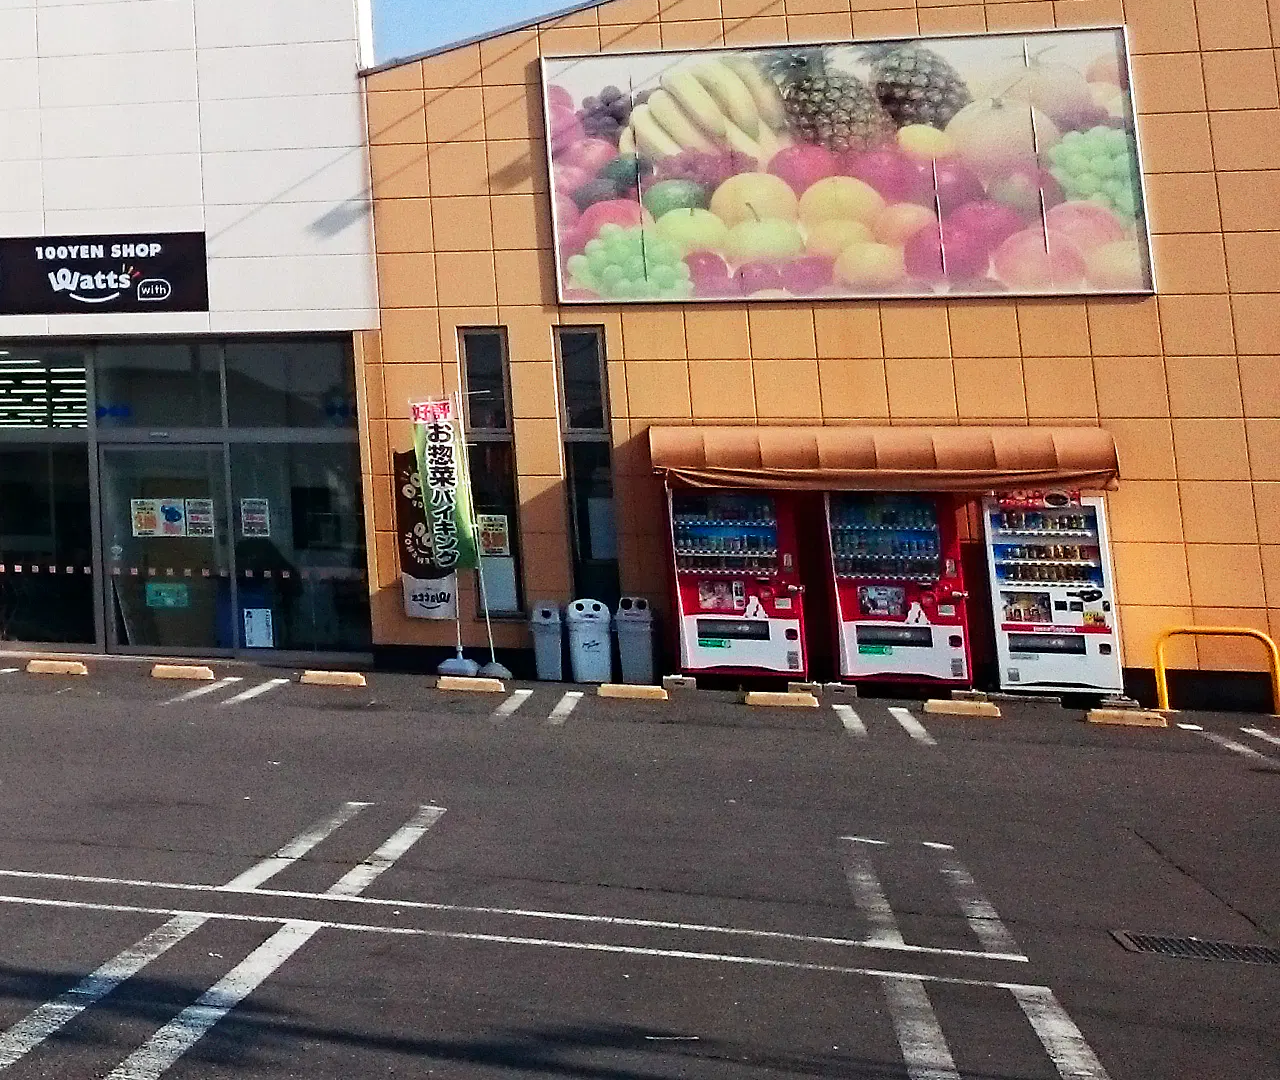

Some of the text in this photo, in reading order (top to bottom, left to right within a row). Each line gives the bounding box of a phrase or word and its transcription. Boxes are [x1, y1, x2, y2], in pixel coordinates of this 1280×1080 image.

[35, 243, 162, 260] 100YEN SHOP
[48, 268, 130, 291] Watts
[141, 284, 167, 295] with
[411, 400, 451, 421] 好評
[428, 423, 459, 567] お惣菜バイキング
